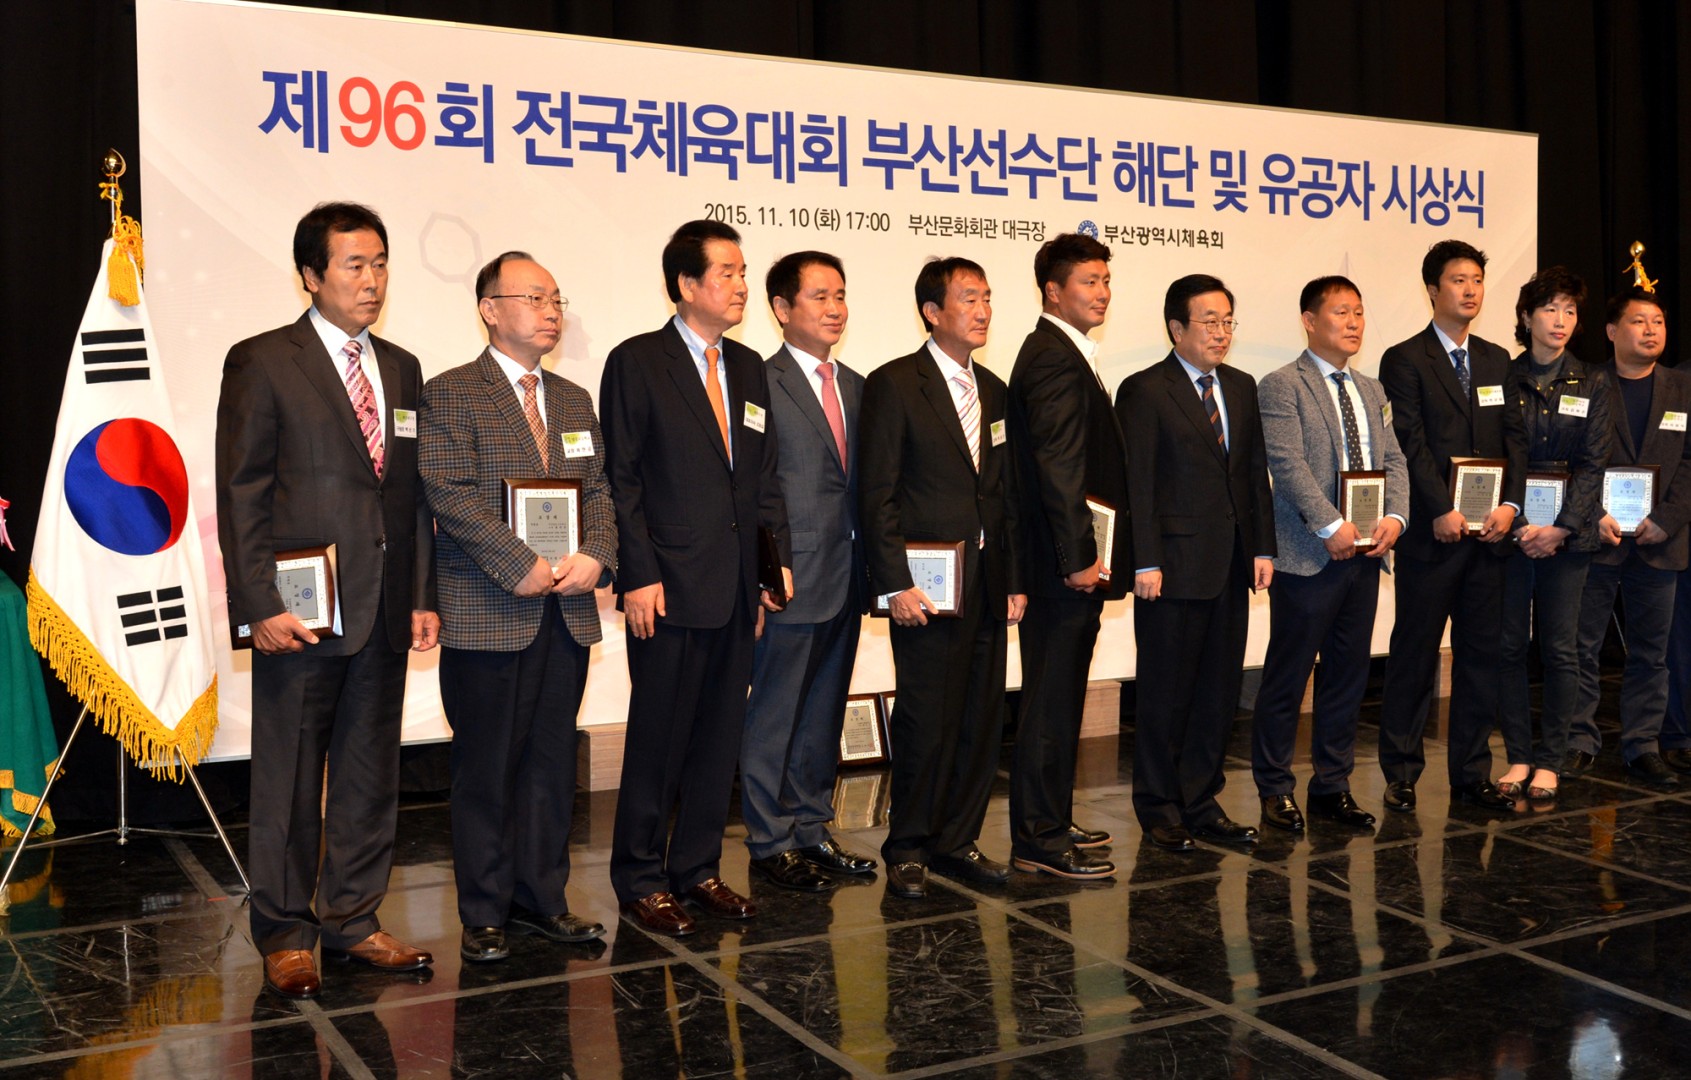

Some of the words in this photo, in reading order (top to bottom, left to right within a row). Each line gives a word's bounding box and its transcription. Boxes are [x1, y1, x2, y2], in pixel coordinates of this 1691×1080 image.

[258, 70, 495, 164] 제96회
[512, 90, 848, 188] 전국체육대회
[862, 119, 1102, 203] 부산선수단
[1112, 140, 1200, 209] 해단
[1210, 150, 1247, 213] 및
[1258, 153, 1376, 221] 유공자
[1382, 165, 1486, 230] 시상식
[704, 202, 752, 226] 2015.
[758, 206, 783, 227] 11.
[846, 211, 891, 232] 17:00
[907, 214, 999, 240] 부산문화회관
[1002, 219, 1047, 243] 대극장
[1104, 224, 1225, 250] 부산광역시체육회
